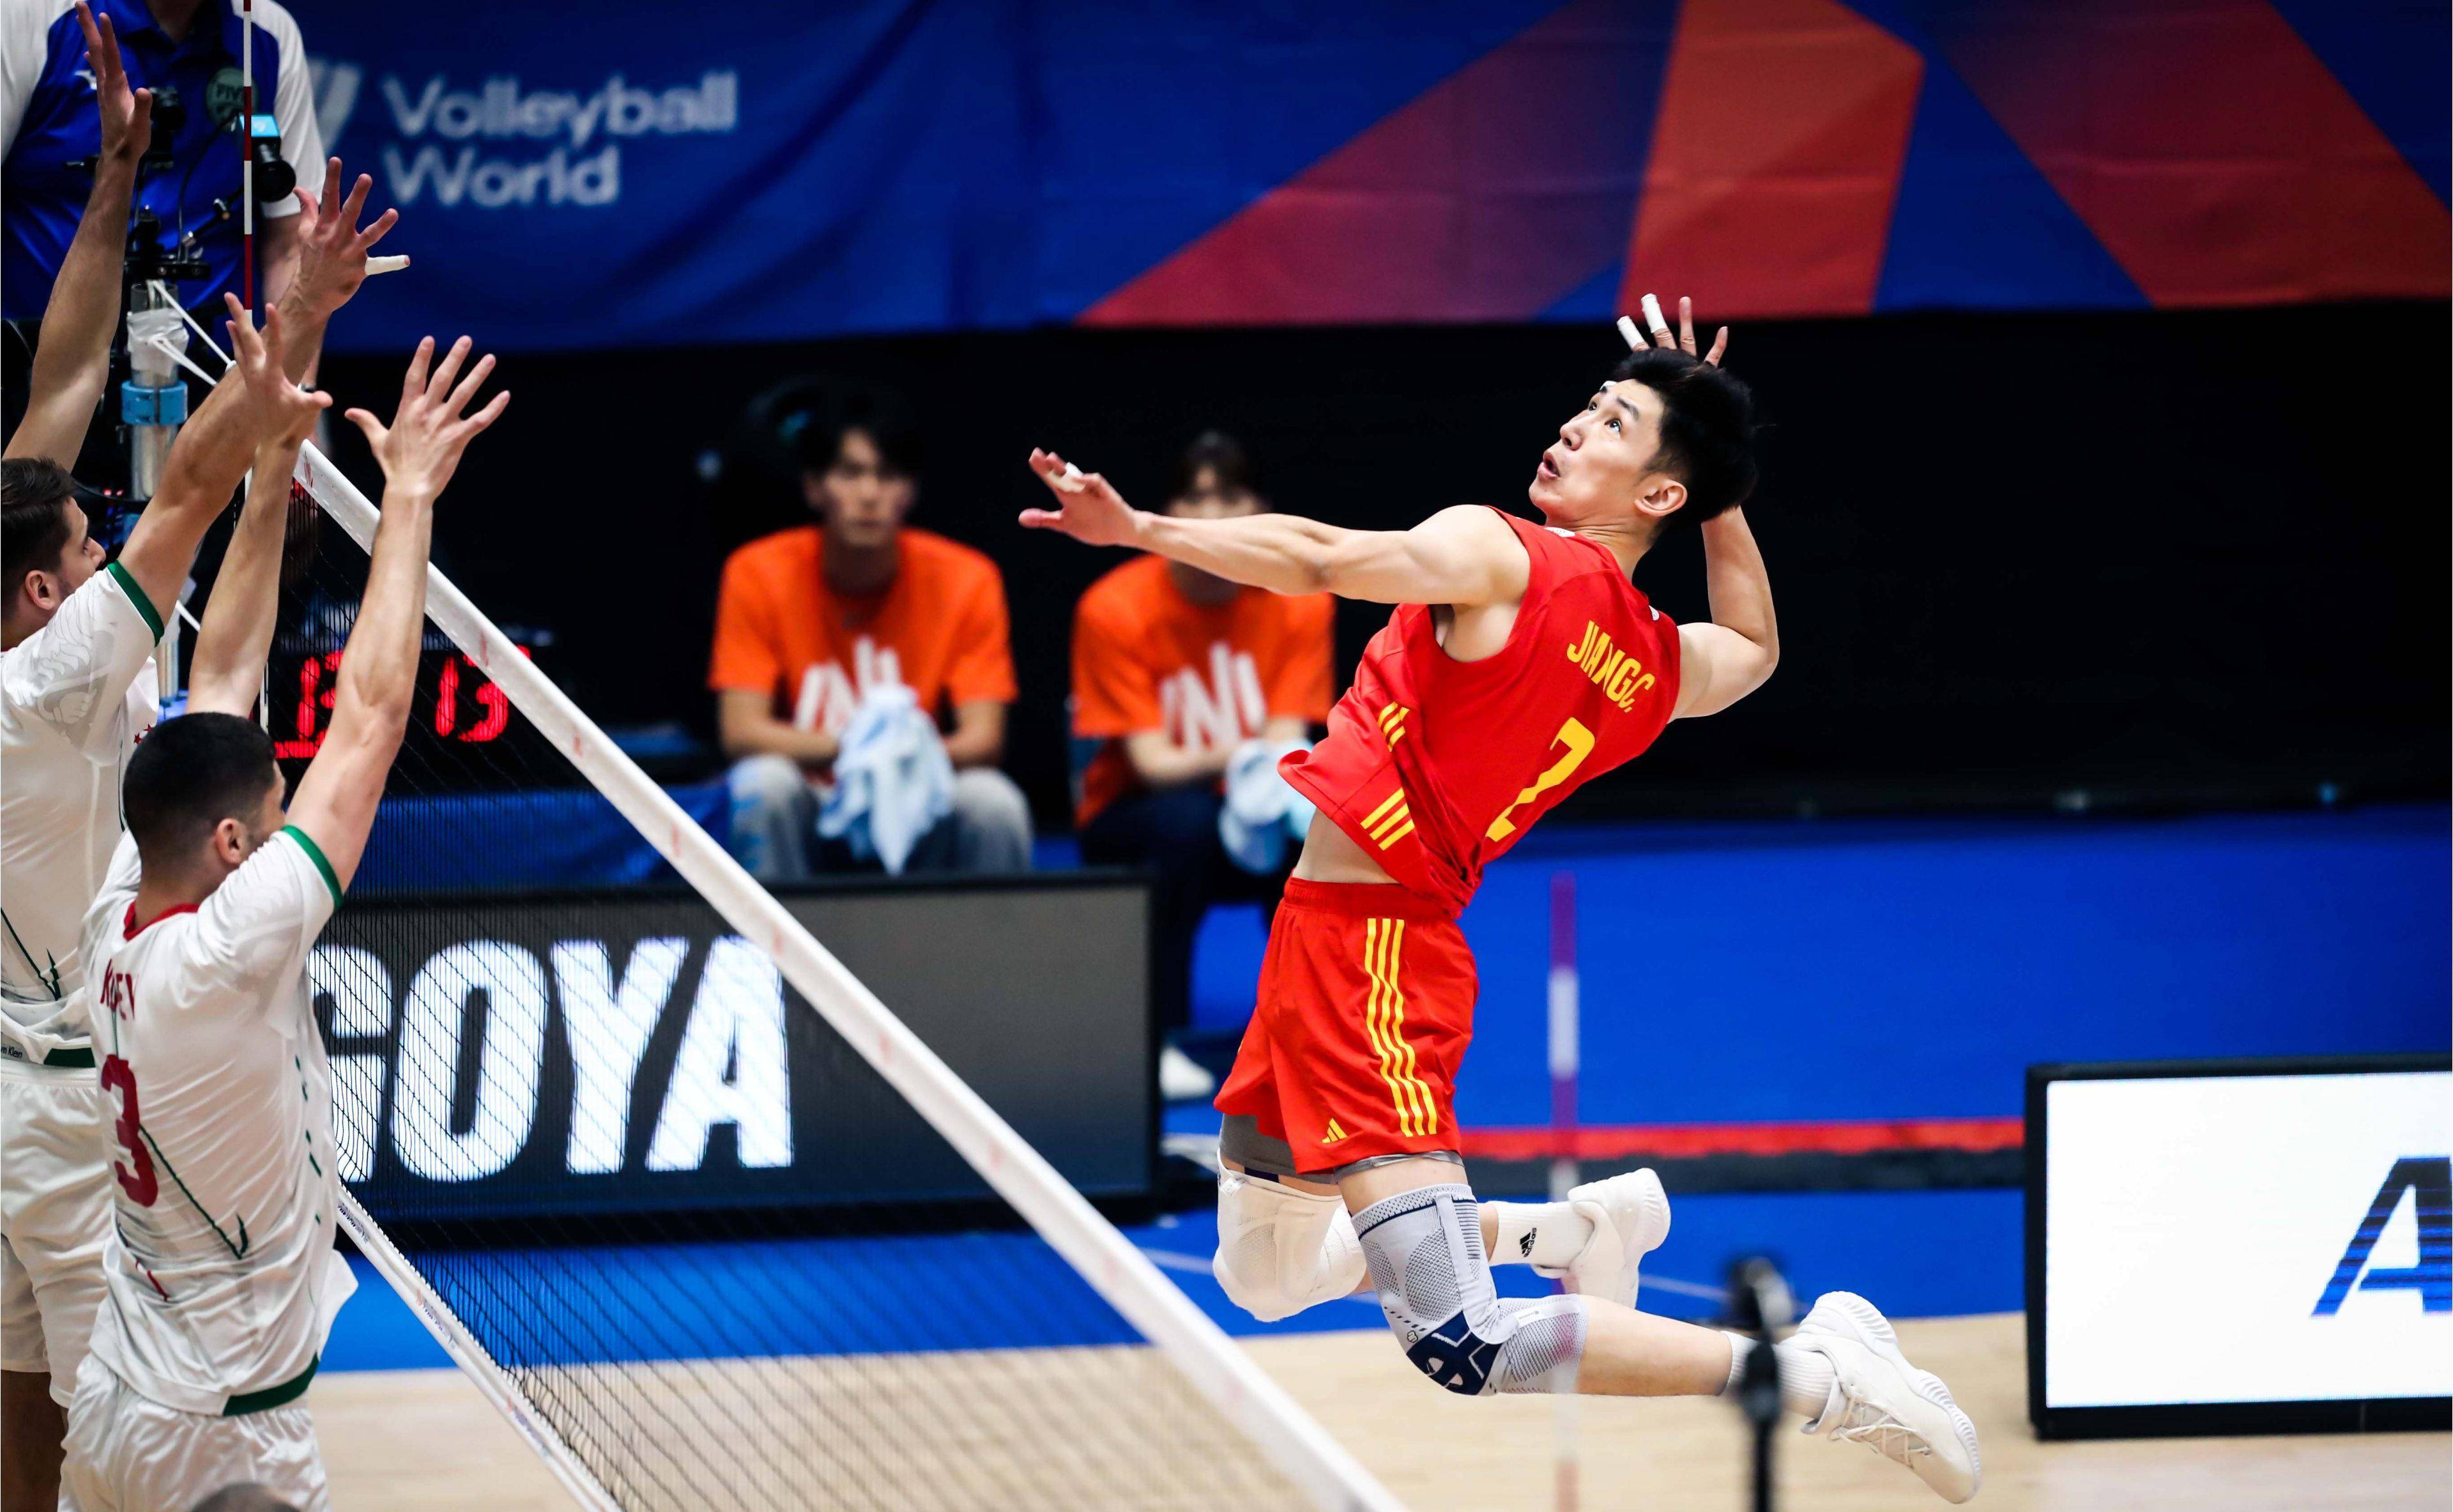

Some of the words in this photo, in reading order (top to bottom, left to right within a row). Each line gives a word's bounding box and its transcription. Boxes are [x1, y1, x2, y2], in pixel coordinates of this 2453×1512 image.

[381, 68, 737, 146] Volleyball
[383, 145, 621, 207] World
[308, 934, 795, 1183] GOYA
[101, 1054, 158, 1208] 3
